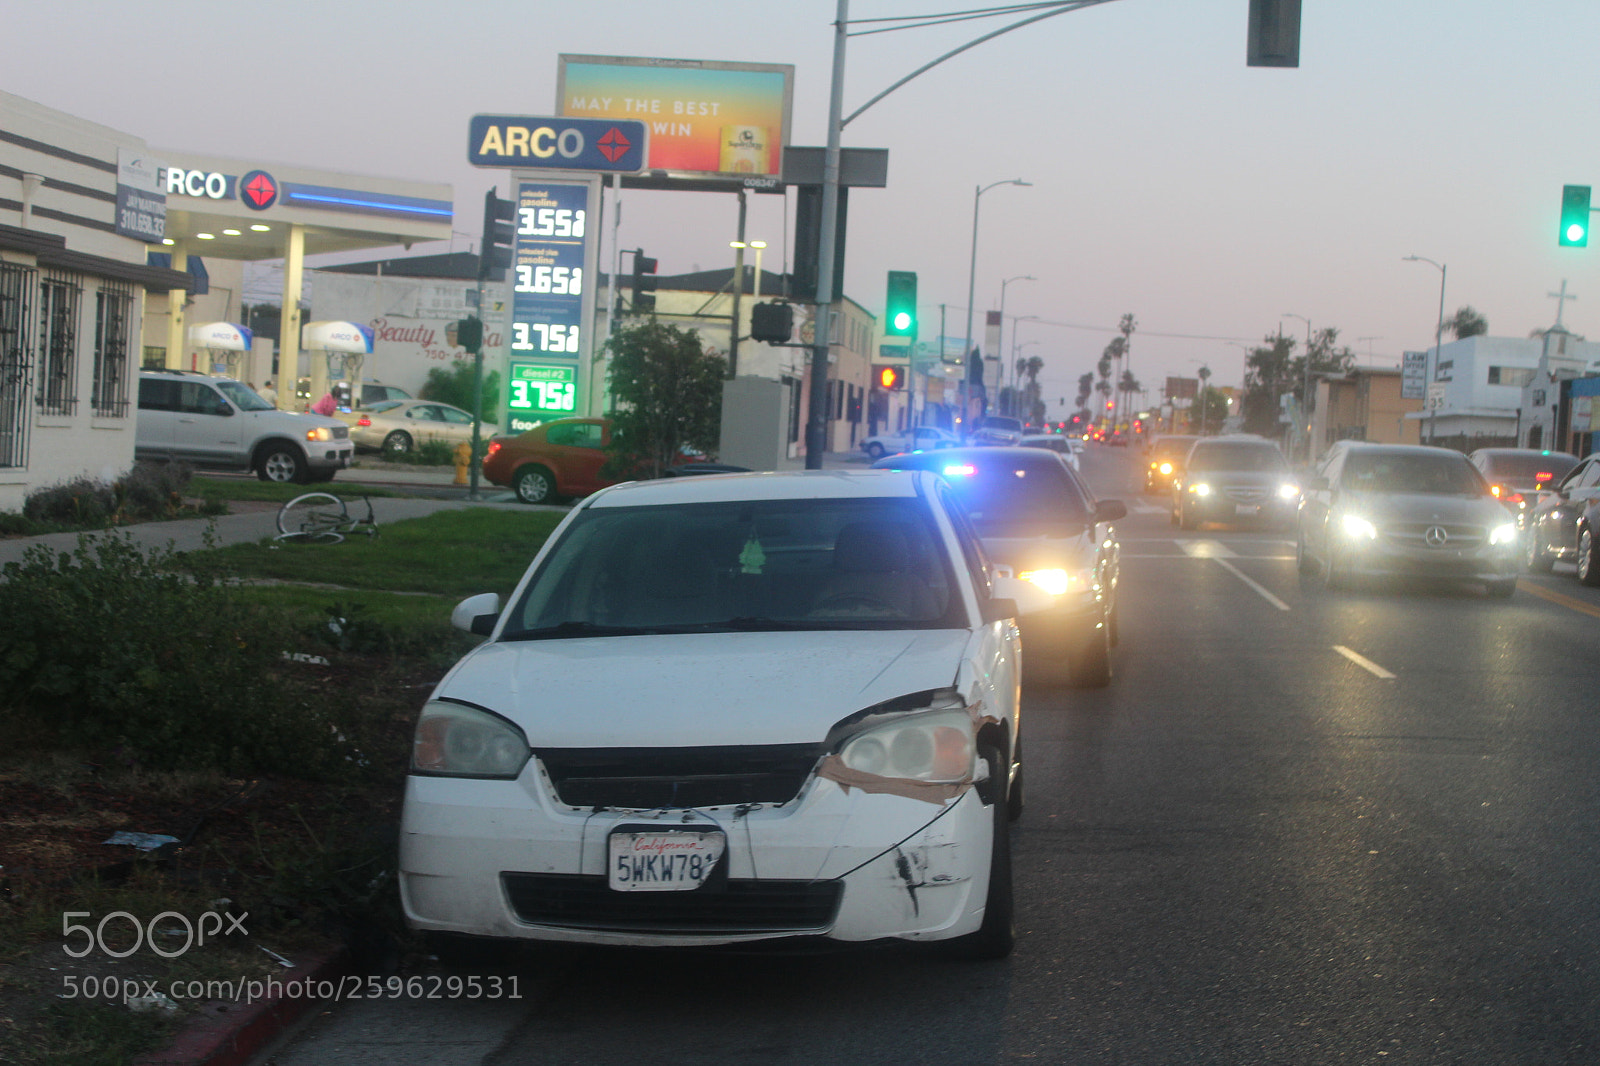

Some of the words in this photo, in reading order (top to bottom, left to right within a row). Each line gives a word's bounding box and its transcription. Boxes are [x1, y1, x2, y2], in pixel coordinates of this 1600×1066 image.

[571, 96, 613, 112] MAY
[624, 97, 661, 114] THE
[673, 100, 720, 117] BEST
[652, 121, 691, 137] WIN
[478, 125, 585, 158] ARCO
[166, 167, 227, 199] RCO
[520, 198, 558, 207] gasoline
[517, 256, 555, 265] gasoline
[371, 318, 438, 349] Beauty
[522, 368, 551, 378] diesel
[552, 370, 565, 379] #2
[634, 837, 704, 854] California
